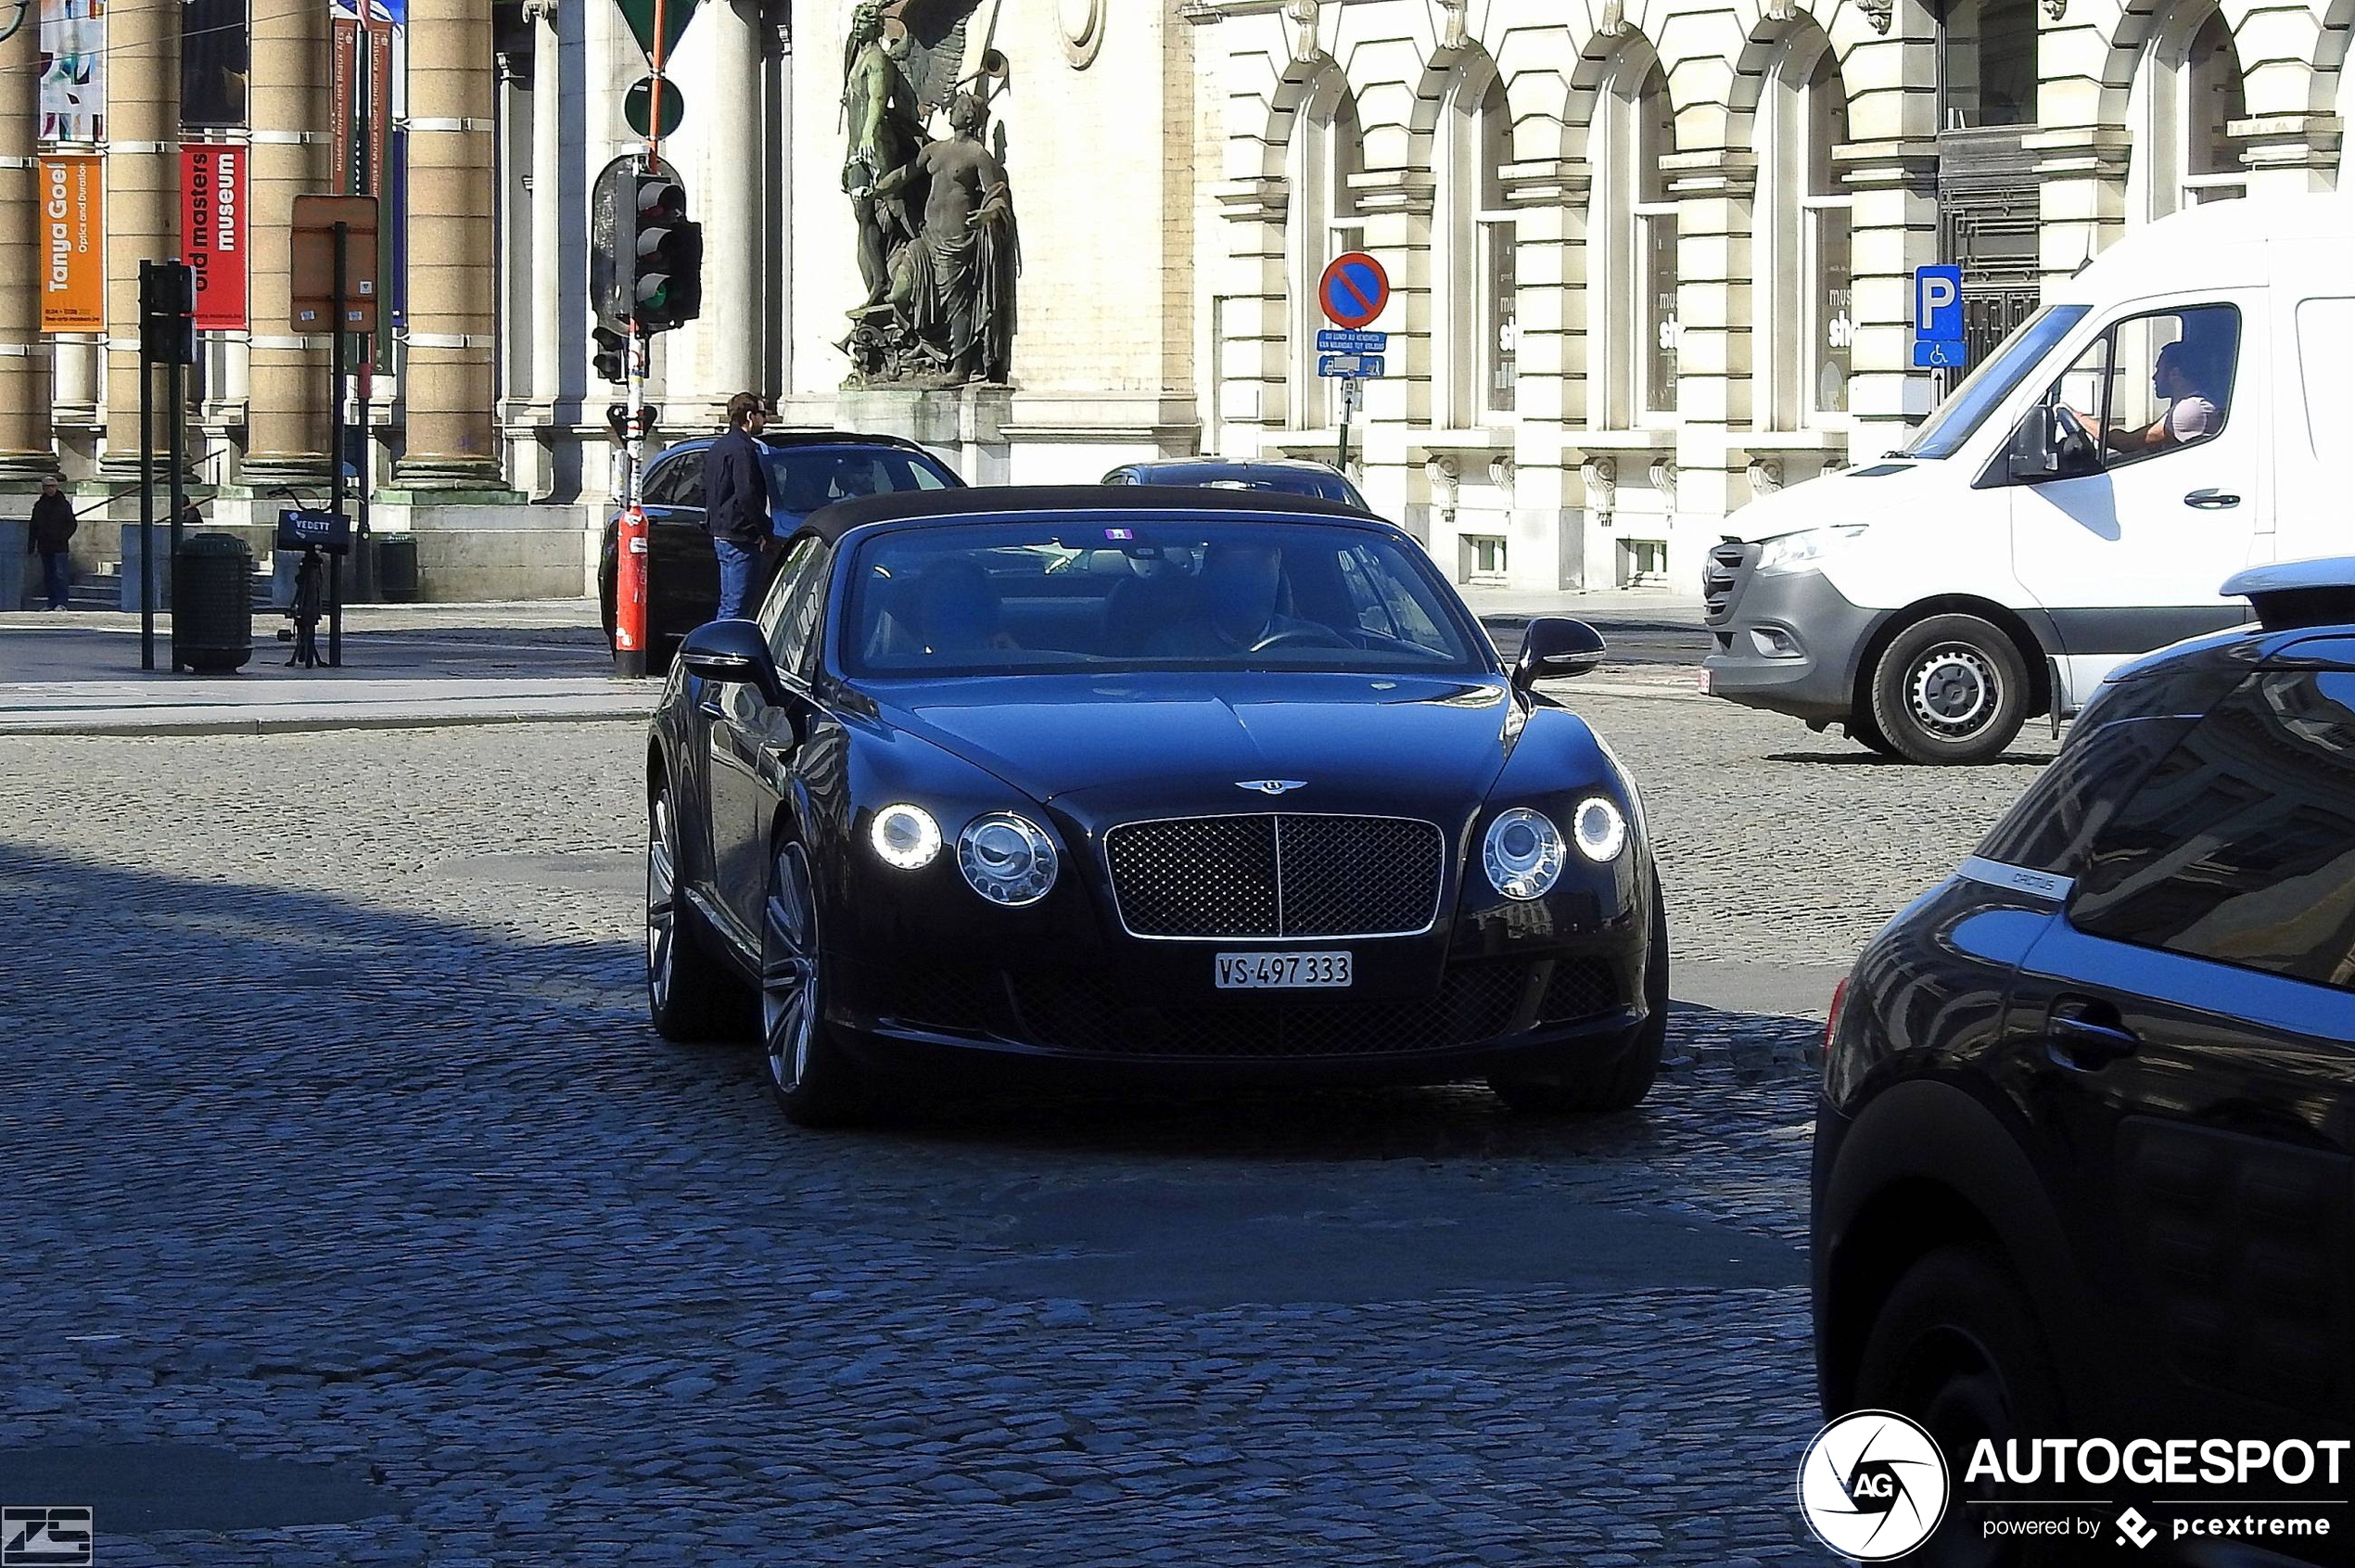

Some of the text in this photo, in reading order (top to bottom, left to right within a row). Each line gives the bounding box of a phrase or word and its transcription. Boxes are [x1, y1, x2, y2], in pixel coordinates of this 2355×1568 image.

[46, 162, 68, 219] Goel
[78, 162, 87, 253] Optics and Duration
[188, 153, 208, 291] old masters
[218, 153, 235, 251] museum
[49, 223, 72, 293] Tanya
[1922, 277, 1955, 330] P
[296, 520, 330, 530] VEDETT
[1305, 957, 1349, 983] 333
